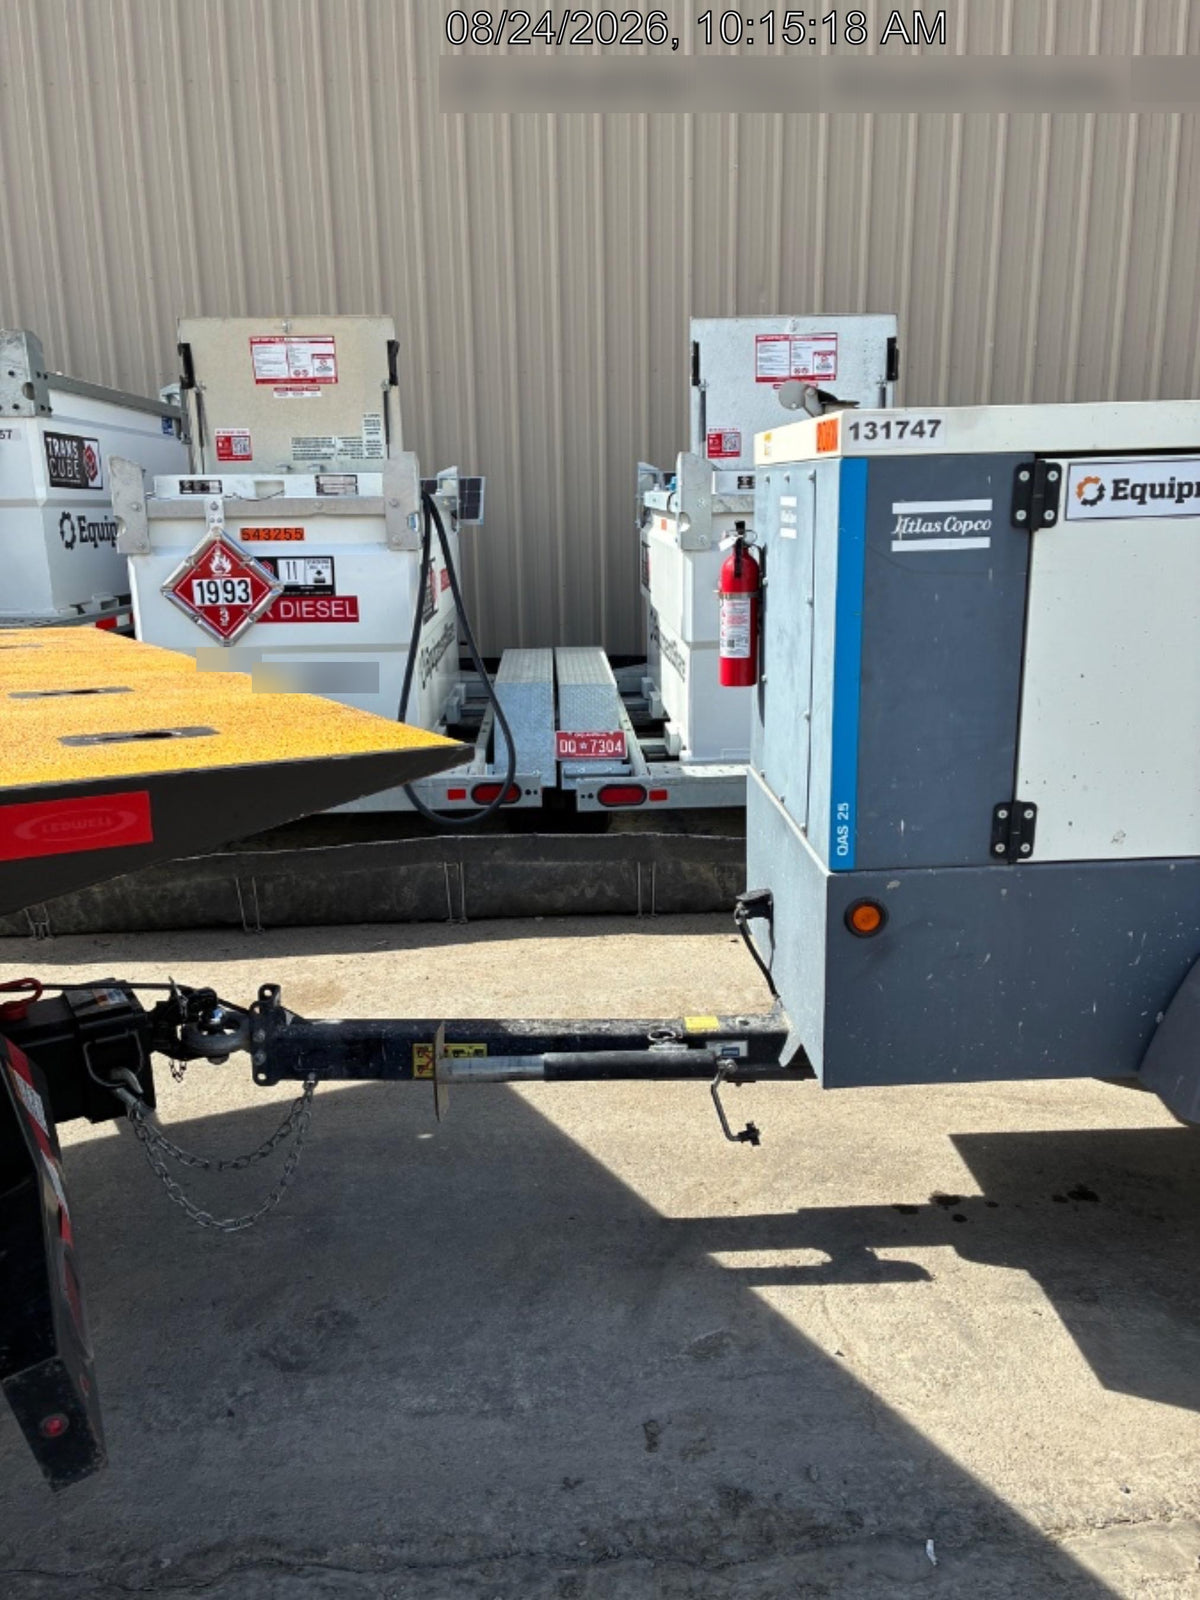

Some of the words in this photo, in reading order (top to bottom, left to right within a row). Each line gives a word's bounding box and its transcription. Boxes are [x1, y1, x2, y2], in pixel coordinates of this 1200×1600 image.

[849, 419, 942, 441] 131747
[46, 438, 79, 458] TRANS
[49, 457, 81, 478] CUBE
[240, 527, 305, 541] 543255
[891, 515, 942, 535] Atlas
[944, 515, 992, 536] Copco
[196, 579, 250, 605] 1993
[280, 601, 358, 618] DIESEL
[836, 802, 849, 820] 25
